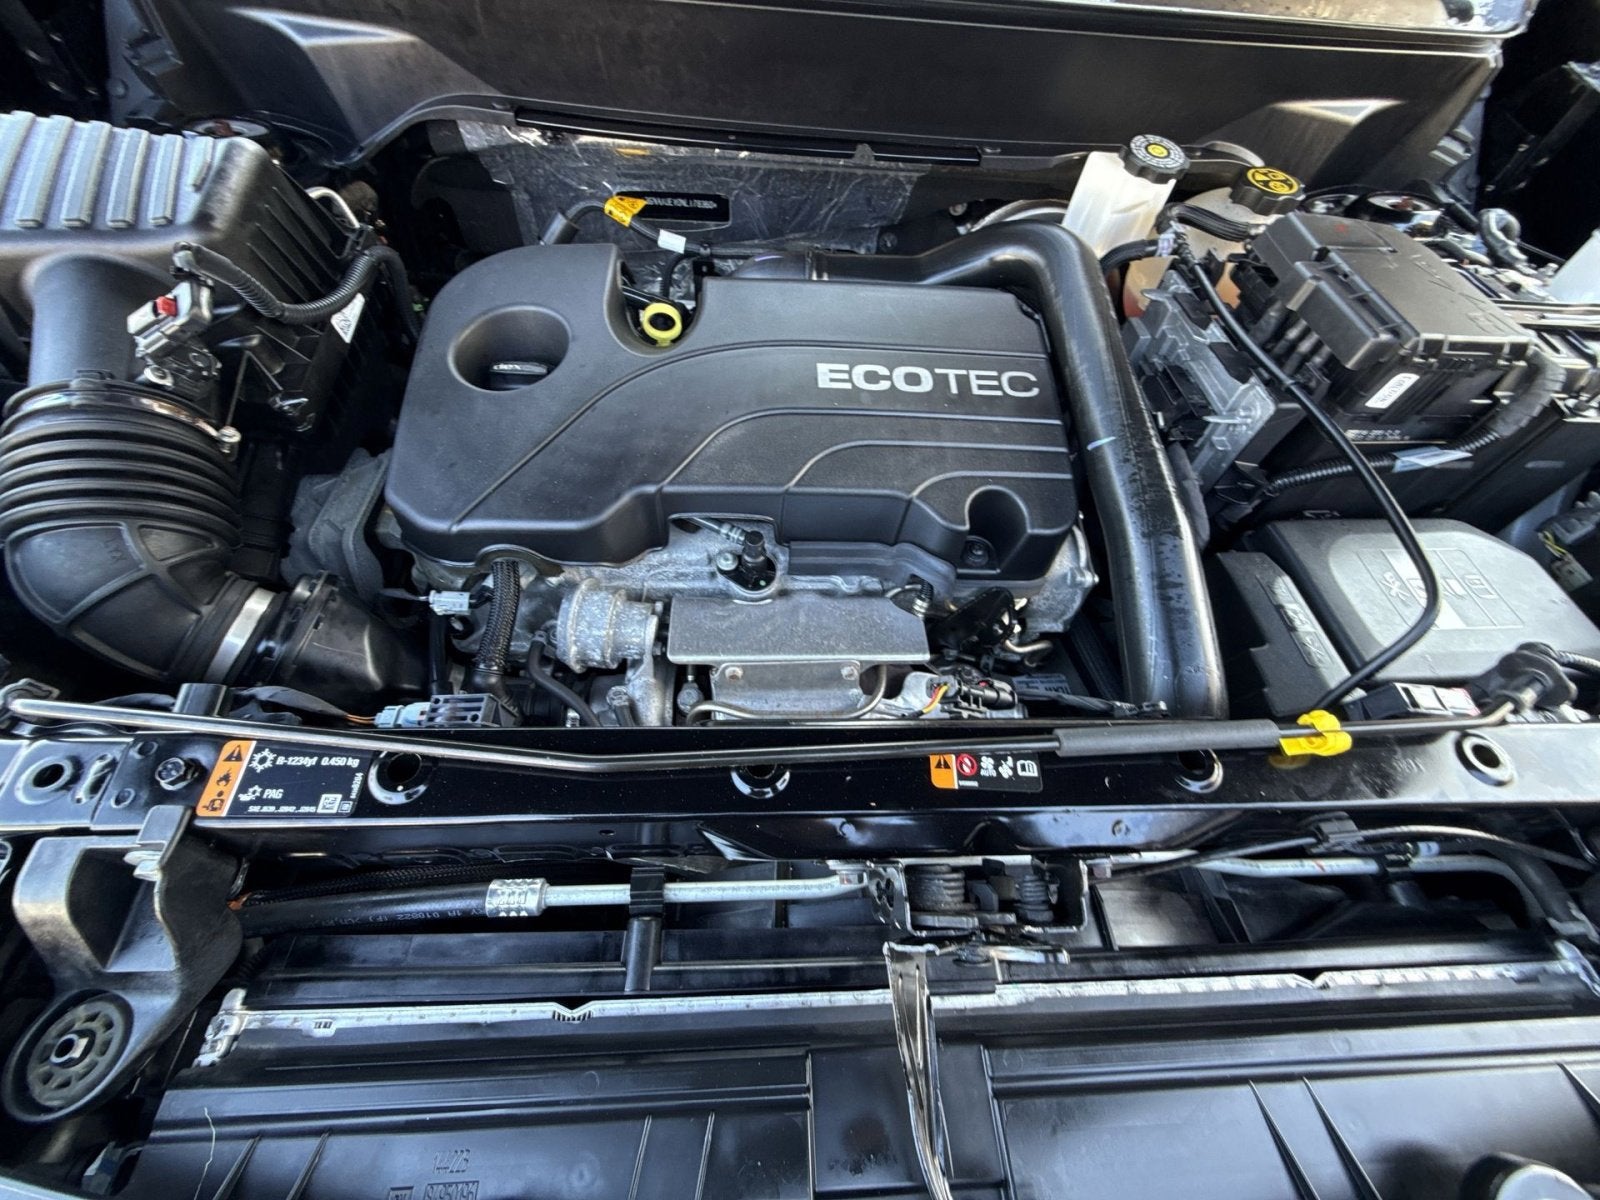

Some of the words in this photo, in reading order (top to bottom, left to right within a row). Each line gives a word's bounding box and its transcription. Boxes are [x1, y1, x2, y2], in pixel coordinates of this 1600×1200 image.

[816, 363, 1040, 398] ECOTEC
[321, 756, 347, 766] 0.450
[347, 757, 360, 768] kg
[262, 788, 284, 799] PAG
